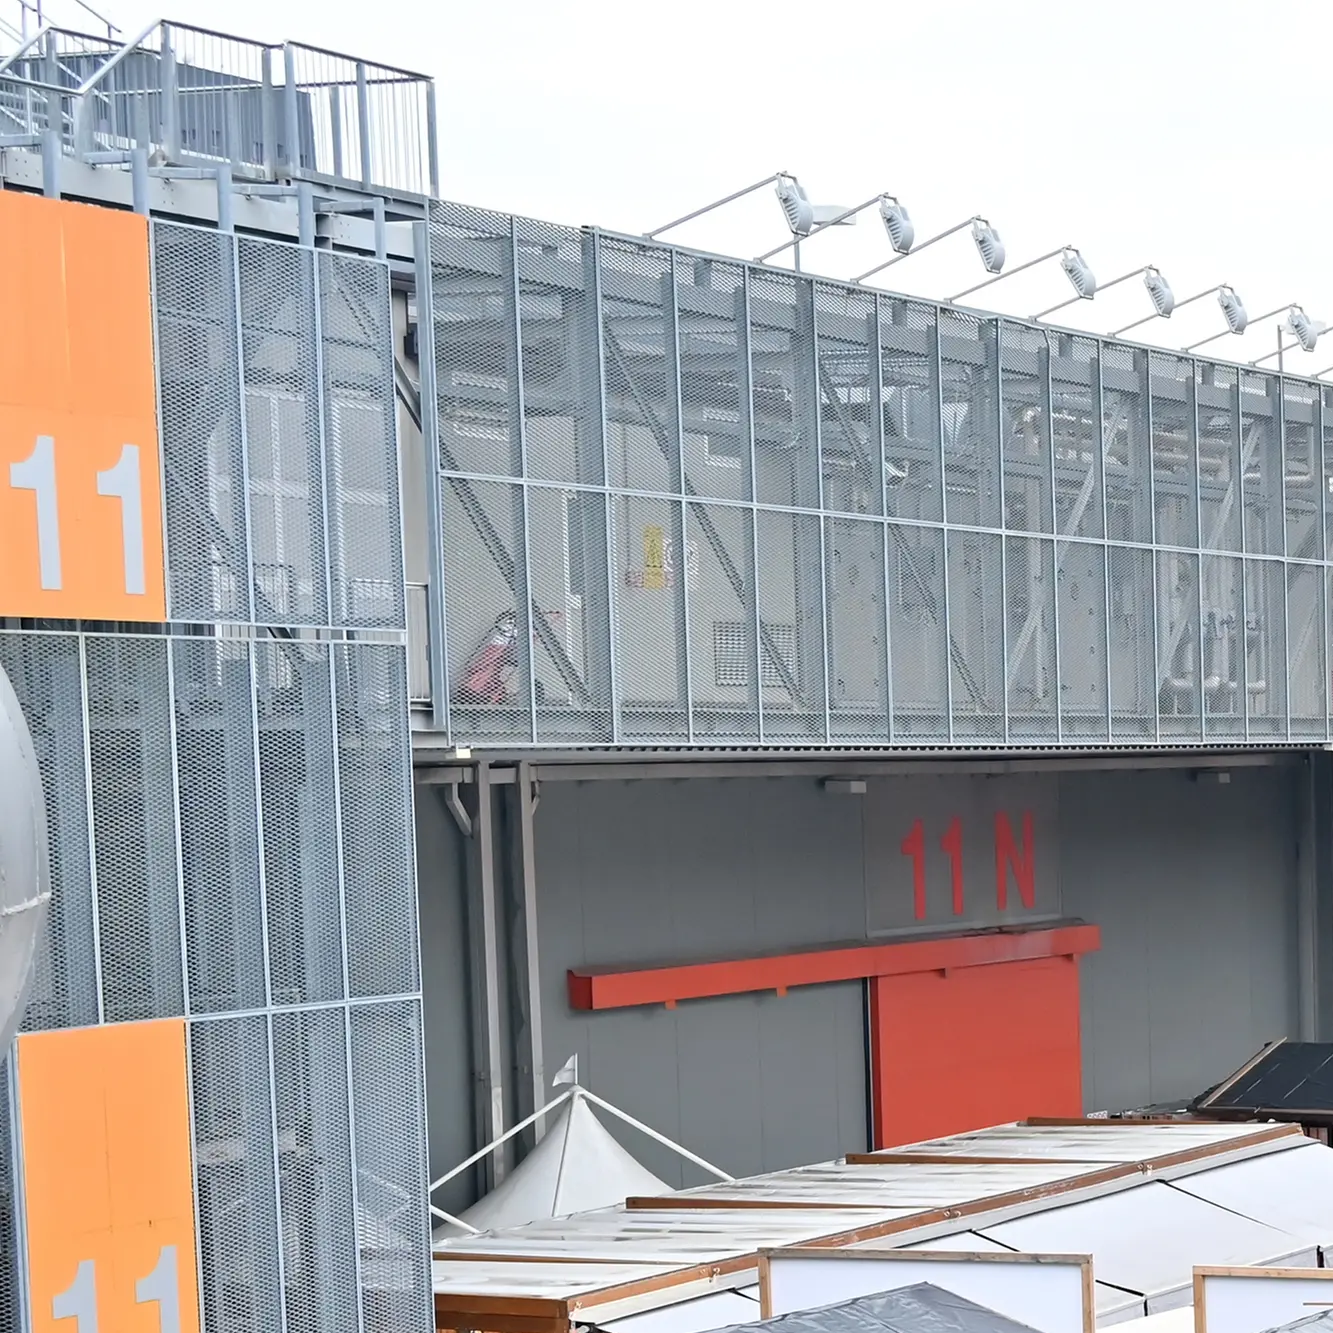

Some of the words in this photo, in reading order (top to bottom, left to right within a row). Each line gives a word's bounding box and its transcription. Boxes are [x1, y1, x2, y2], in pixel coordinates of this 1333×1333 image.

[9, 435, 146, 596] 11
[901, 815, 964, 921] 11
[993, 810, 1036, 910] N
